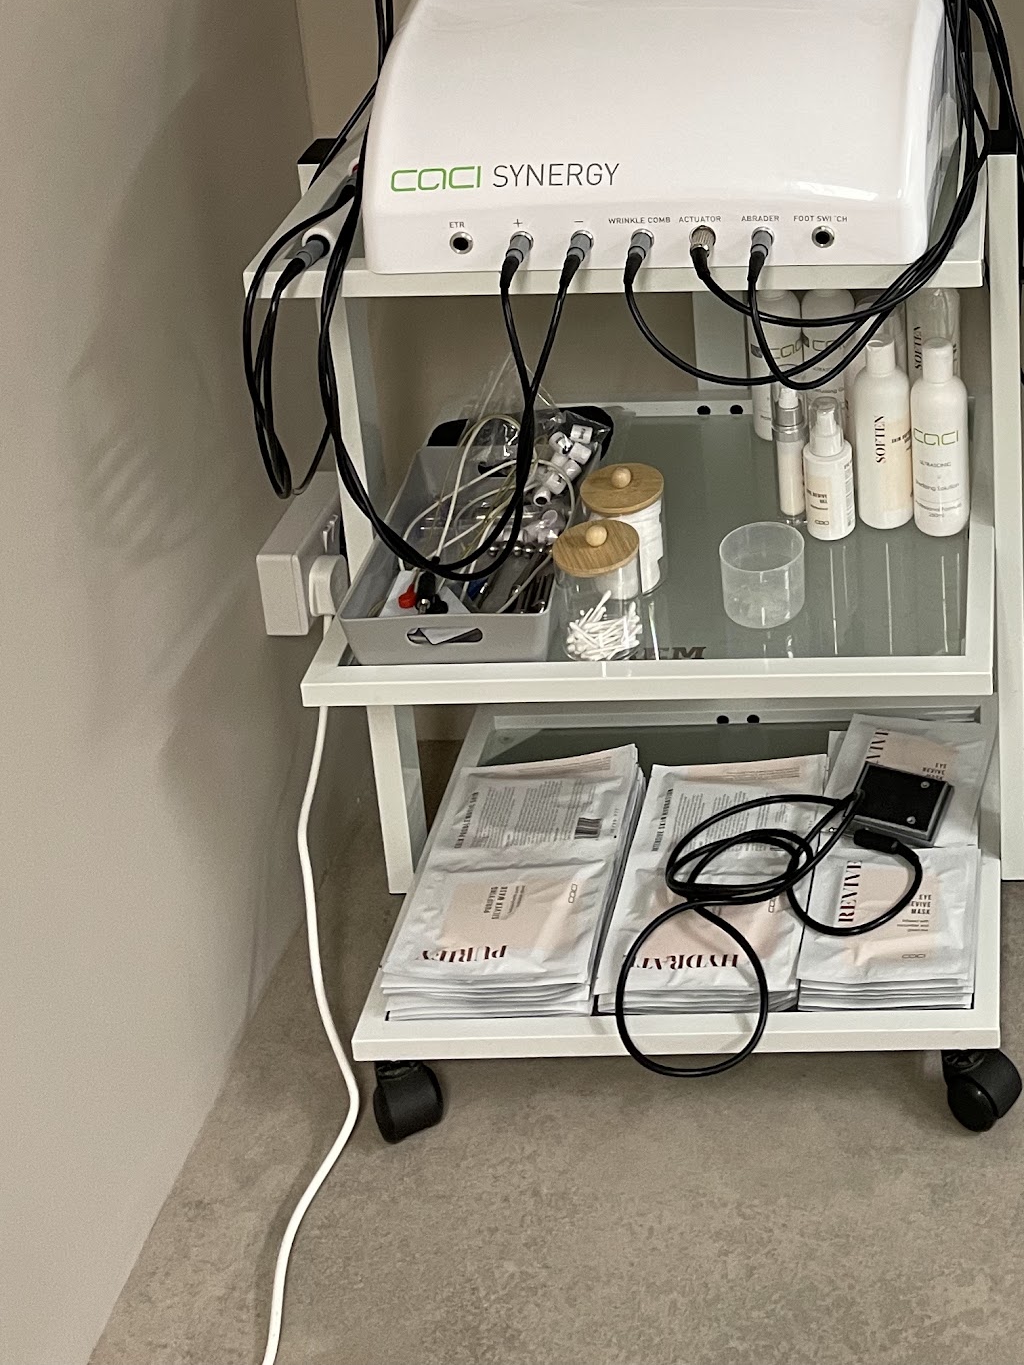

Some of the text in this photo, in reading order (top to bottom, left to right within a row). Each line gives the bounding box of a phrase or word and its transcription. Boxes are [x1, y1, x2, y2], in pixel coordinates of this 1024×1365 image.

[493, 163, 620, 187] SYNERGY
[449, 221, 465, 229] ETR
[678, 215, 722, 223] ACTUATOR
[913, 324, 922, 371] SOFTEN
[874, 415, 886, 464] SOFTEN
[838, 860, 863, 922] REVIVE
[910, 900, 931, 908] EVIVE
[625, 953, 739, 970] HYDRAT
